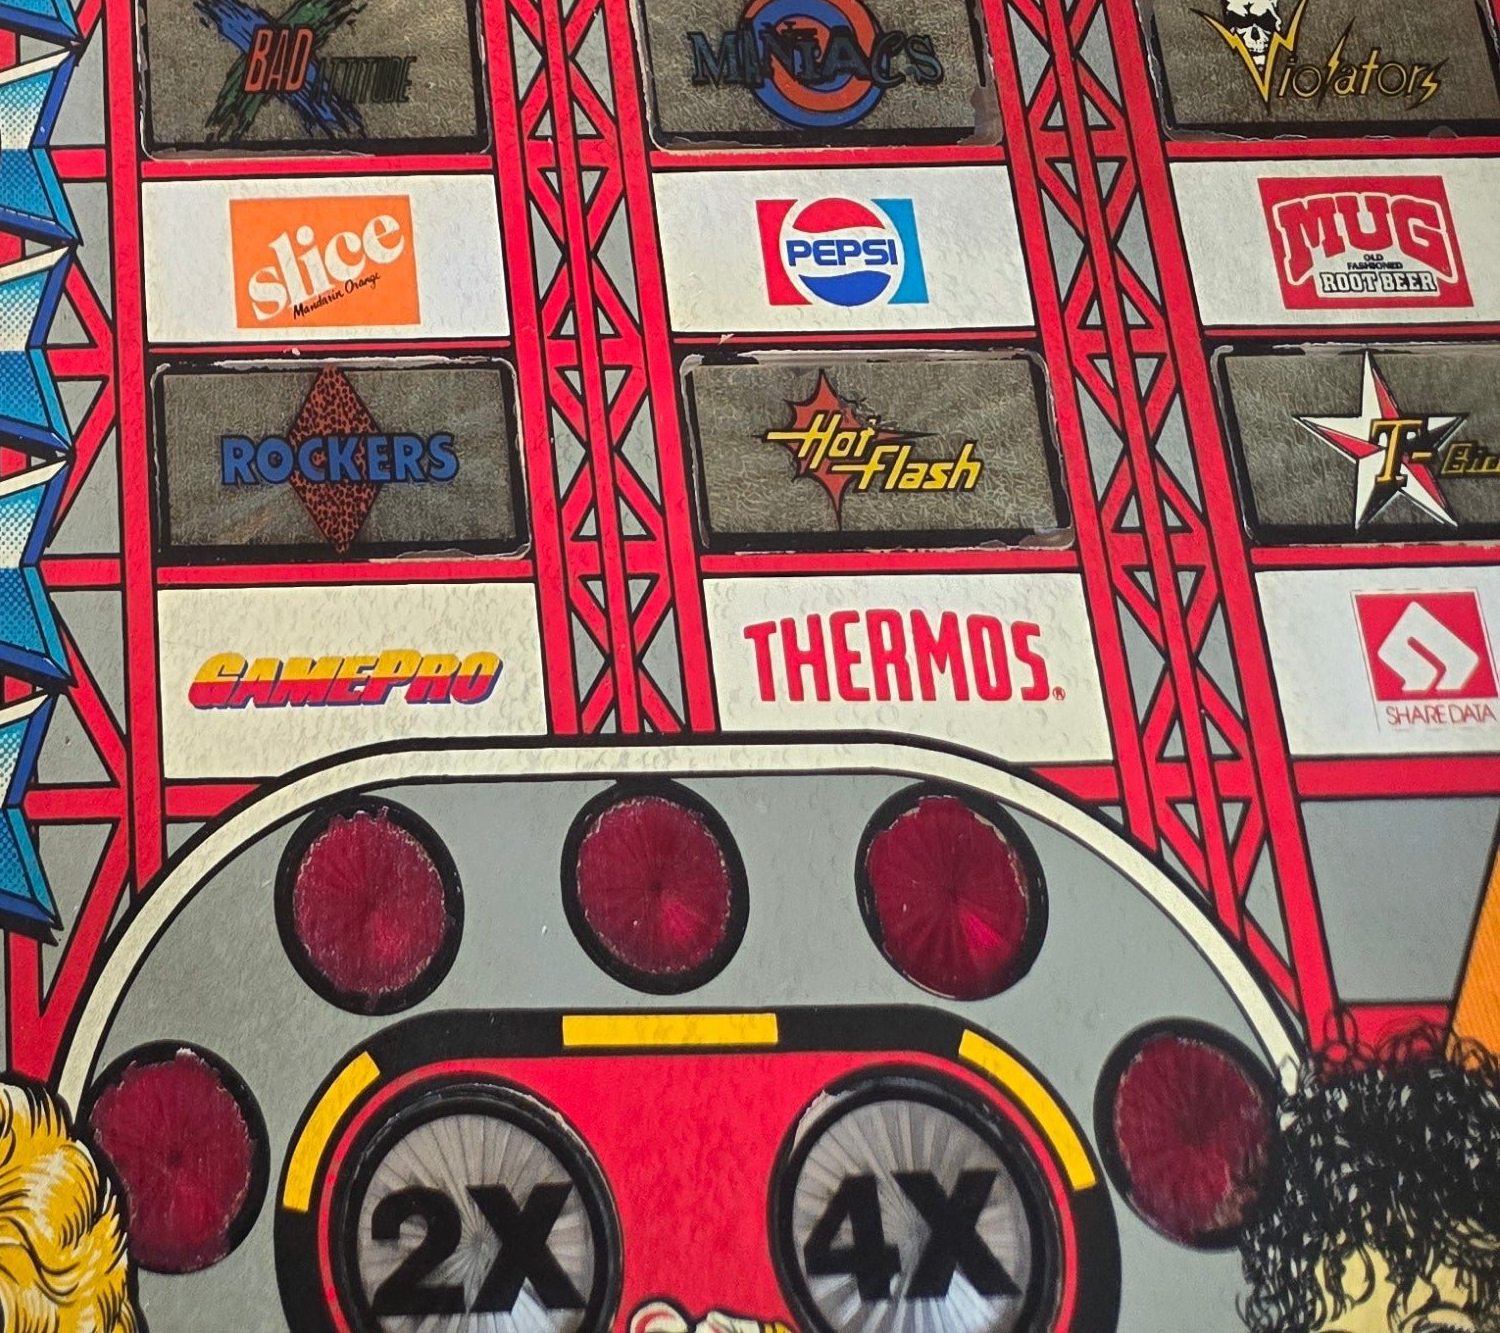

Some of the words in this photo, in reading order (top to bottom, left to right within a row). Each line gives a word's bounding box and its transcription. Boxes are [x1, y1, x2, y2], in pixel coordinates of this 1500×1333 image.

[244, 27, 314, 93] BAD
[686, 23, 945, 89] MANIACS
[247, 213, 406, 322] slice
[785, 238, 899, 267] PEPSI
[1273, 193, 1455, 281] MUG
[1346, 261, 1404, 270] FASHIONED
[1363, 253, 1384, 262] OLD
[293, 288, 344, 321] Mandarin
[345, 271, 382, 297] Orange
[1319, 271, 1378, 293] ROOT
[1378, 270, 1438, 292] BEER
[219, 431, 461, 487] ROCKERS
[370, 1182, 589, 1317] 2X
[803, 1167, 1022, 1302] 4X
